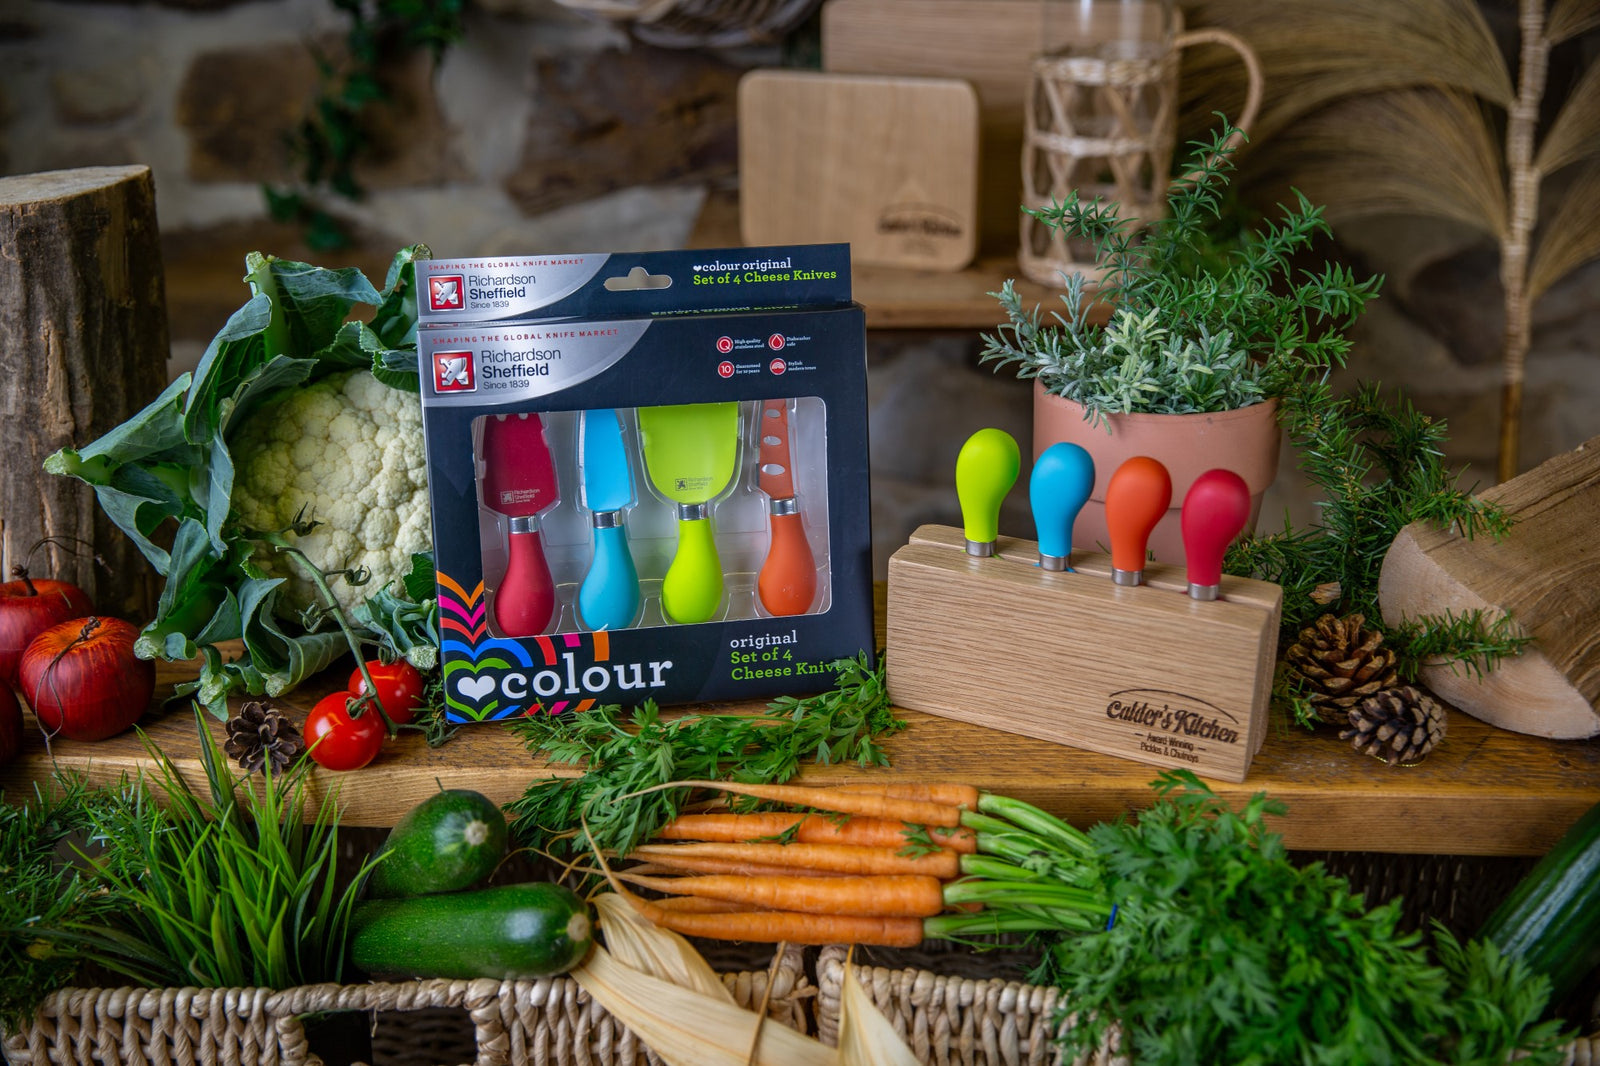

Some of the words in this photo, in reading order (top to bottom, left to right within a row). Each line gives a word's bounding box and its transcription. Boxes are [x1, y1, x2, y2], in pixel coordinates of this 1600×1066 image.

[702, 260, 740, 272] colour
[742, 257, 792, 272] original
[468, 273, 536, 287] Richardson
[693, 274, 714, 285] Set
[717, 272, 731, 284] of
[733, 275, 741, 285] 4
[744, 271, 790, 283] Cheese
[793, 269, 837, 281] Knives
[469, 286, 526, 300] Sheffield
[470, 301, 491, 309] Since
[492, 300, 510, 308] 1839
[433, 336, 477, 345] SHAPING
[503, 333, 542, 341] GLOBAL
[546, 331, 575, 339] KNIFE
[579, 329, 619, 337] MARKET
[481, 348, 562, 363] Richardson
[482, 363, 549, 379] Sheffield
[721, 365, 731, 374] 10
[483, 380, 507, 390] Since
[509, 379, 530, 388] 1839
[730, 629, 798, 650] original
[730, 651, 757, 664] Set
[762, 646, 779, 661] of
[782, 649, 793, 661] 4
[501, 652, 673, 699] colour
[731, 666, 792, 680] Cheese
[1106, 700, 1173, 730] Calder's
[1173, 709, 1239, 744] Kitchen
[1140, 741, 1162, 755] Pickles
[1163, 746, 1169, 756] &
[1147, 732, 1168, 745] Award
[1169, 736, 1194, 751] Winning
